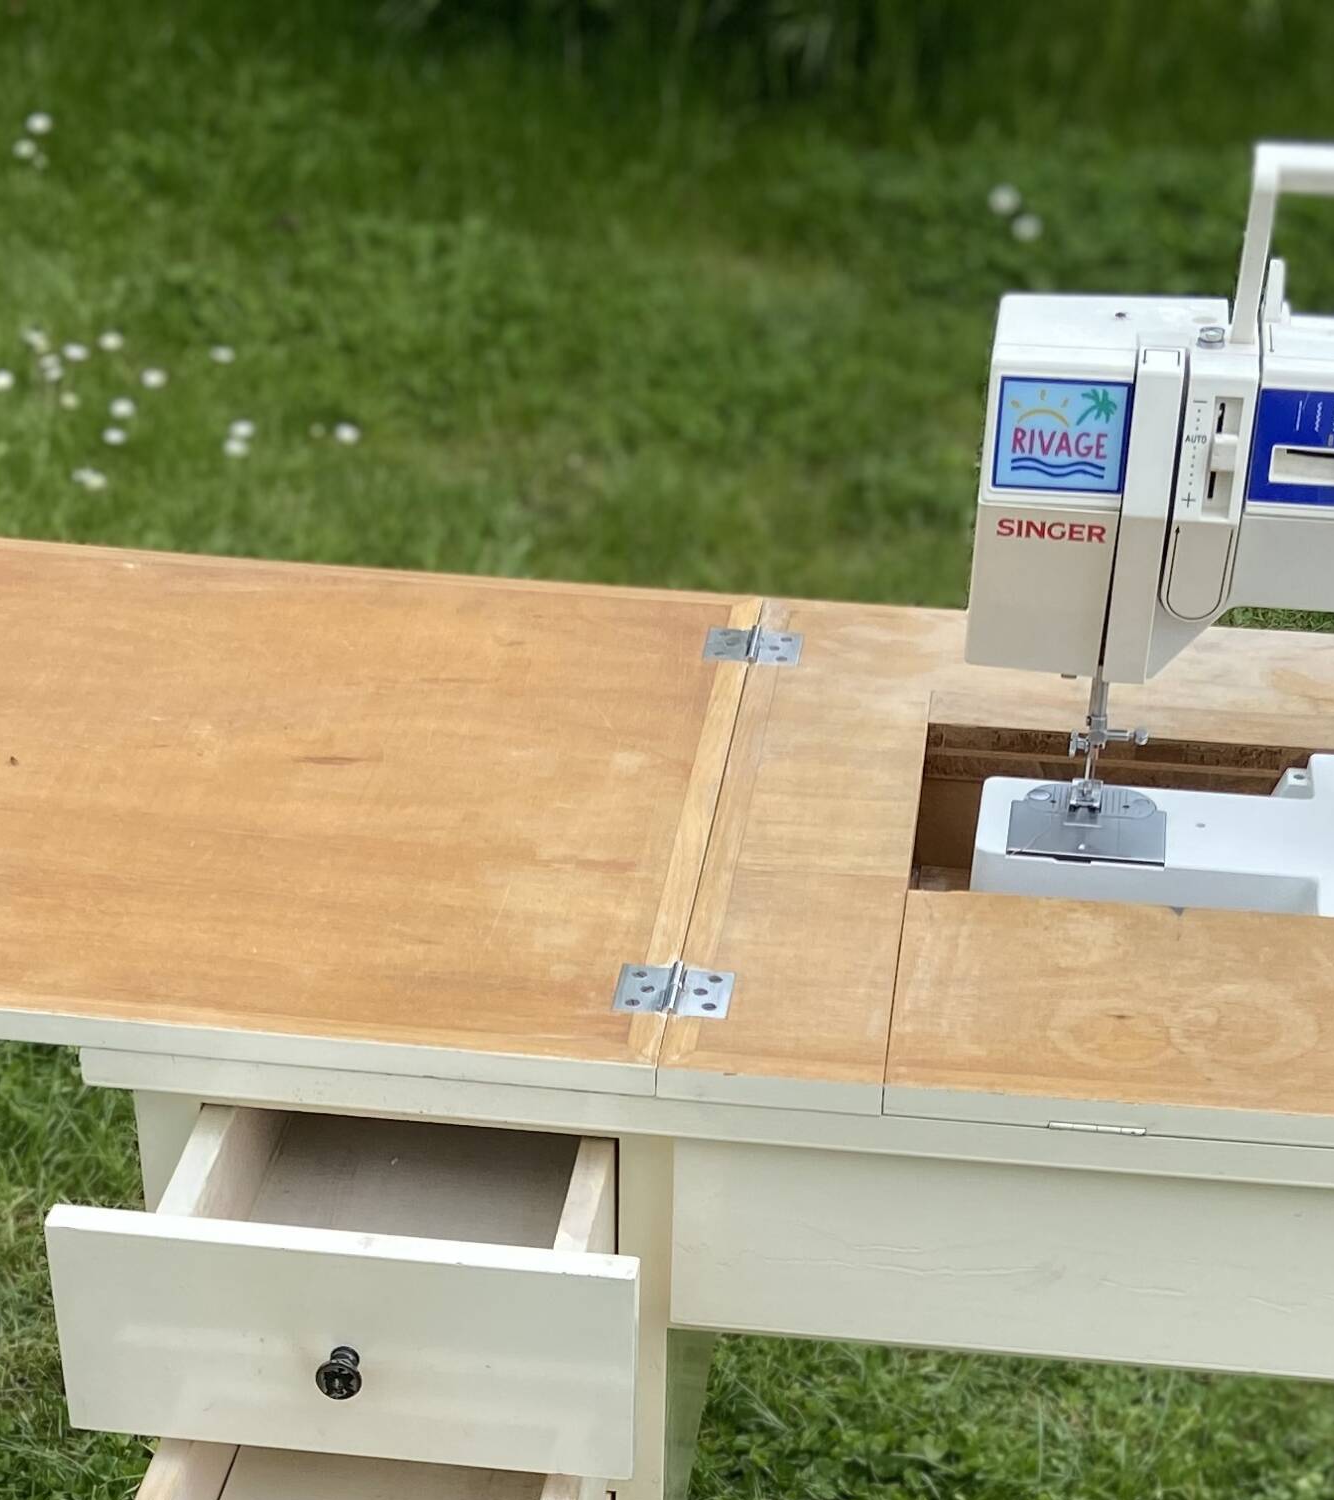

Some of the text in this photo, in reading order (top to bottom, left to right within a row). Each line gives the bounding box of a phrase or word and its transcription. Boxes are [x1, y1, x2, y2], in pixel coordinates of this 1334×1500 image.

[1011, 426, 1108, 460] RIVAGE
[1185, 434, 1207, 444] AUTO
[996, 518, 1106, 543] SINGER
